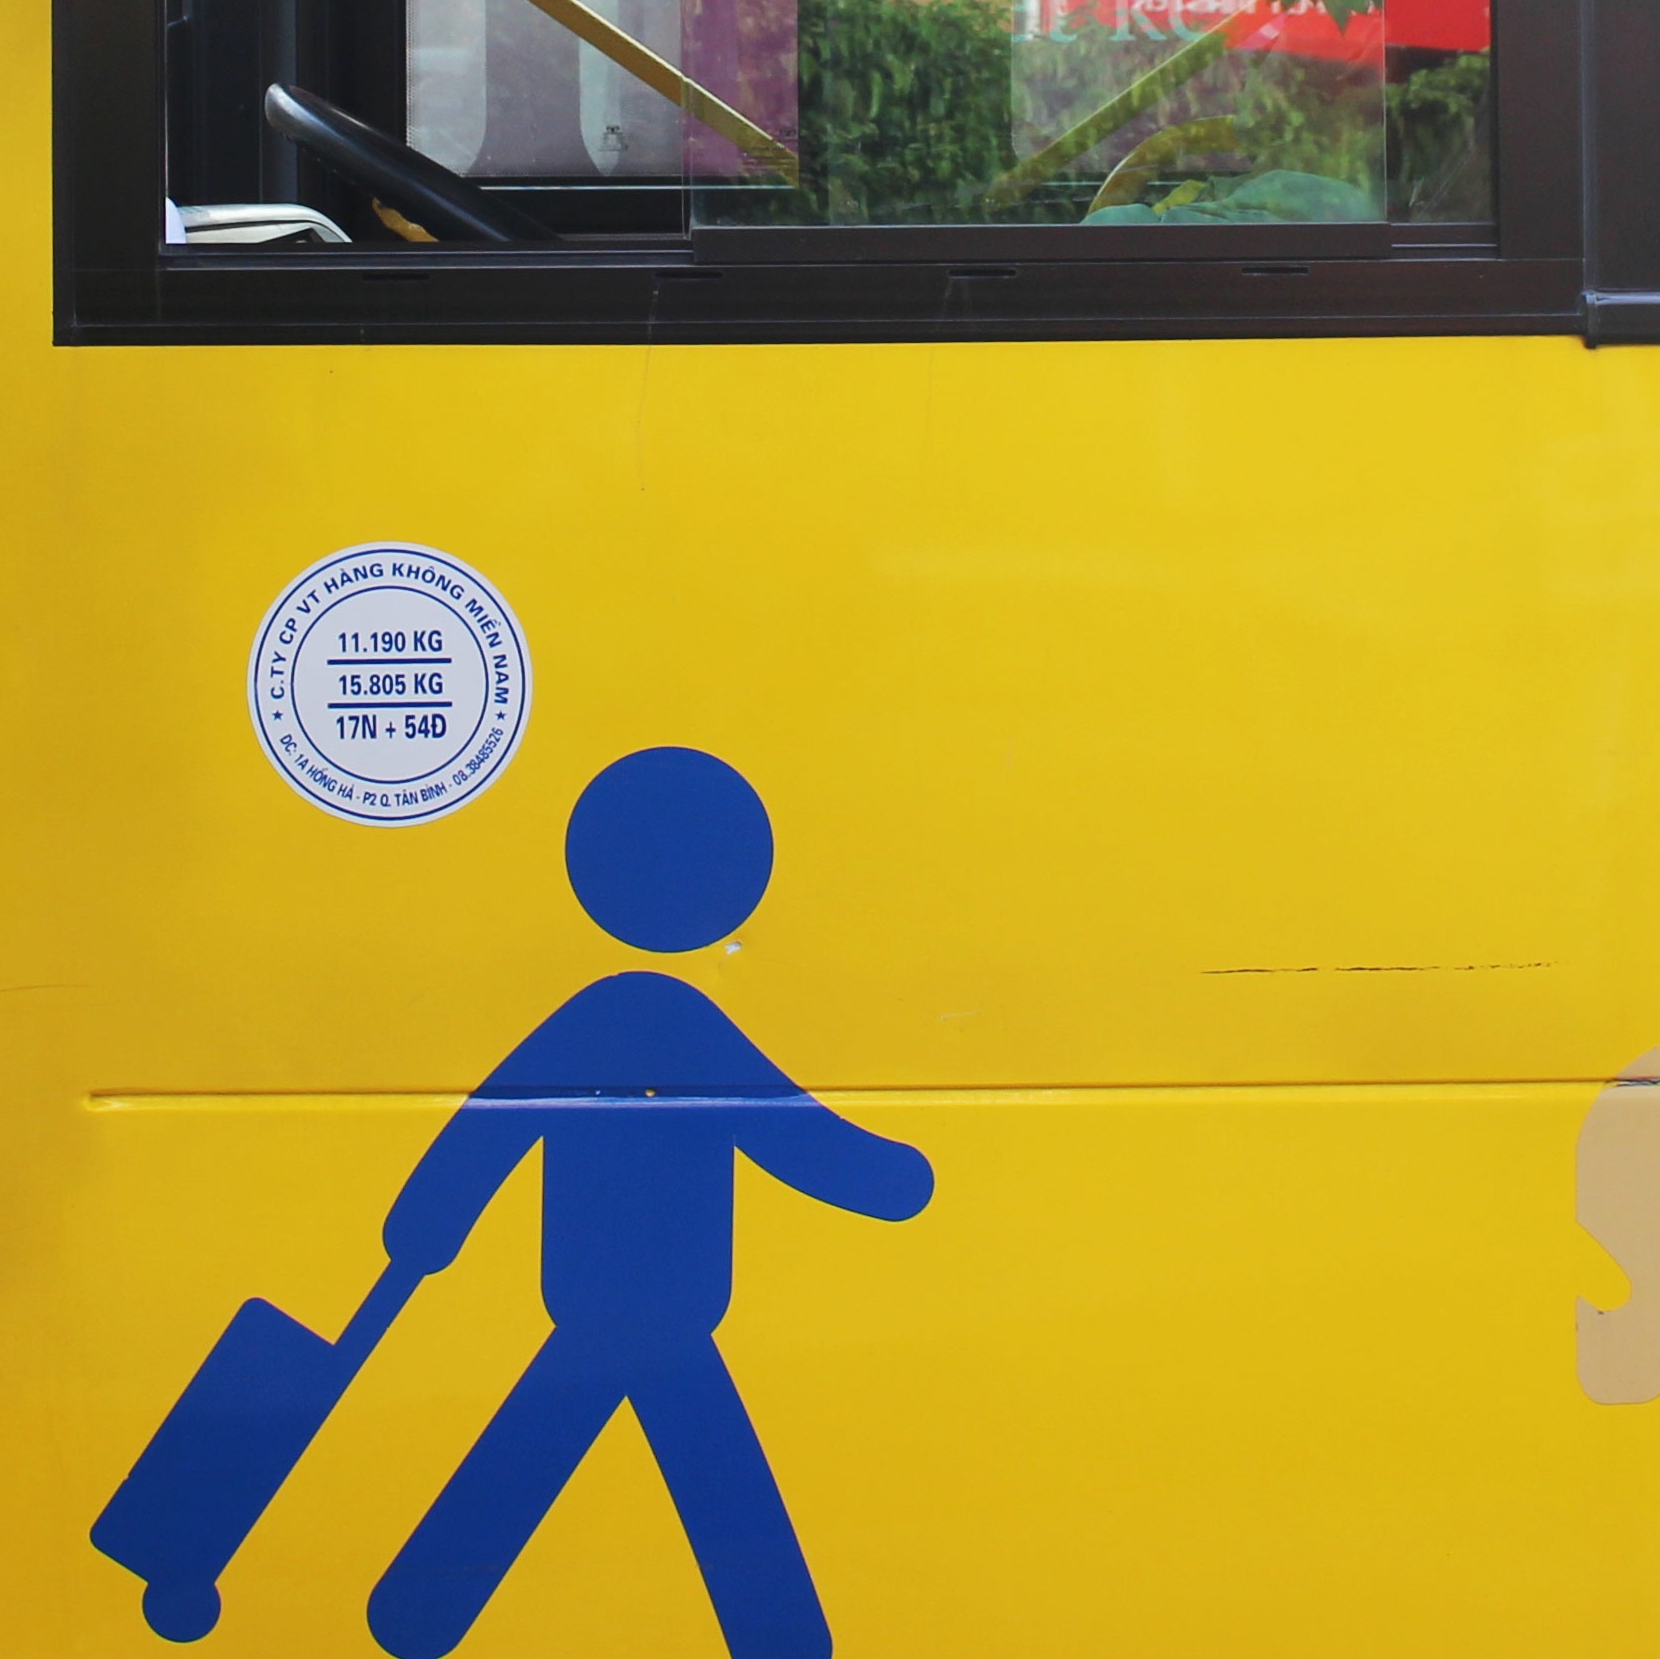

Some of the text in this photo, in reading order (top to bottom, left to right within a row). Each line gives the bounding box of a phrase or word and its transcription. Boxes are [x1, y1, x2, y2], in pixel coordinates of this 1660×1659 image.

[279, 618, 297, 645] CP
[296, 589, 320, 614] VT
[392, 563, 464, 600] KHÔNG
[493, 654, 509, 704] NAM
[338, 630, 443, 653] 11.190 KG
[338, 672, 443, 695] 15.805 KG
[335, 714, 377, 739] 17N
